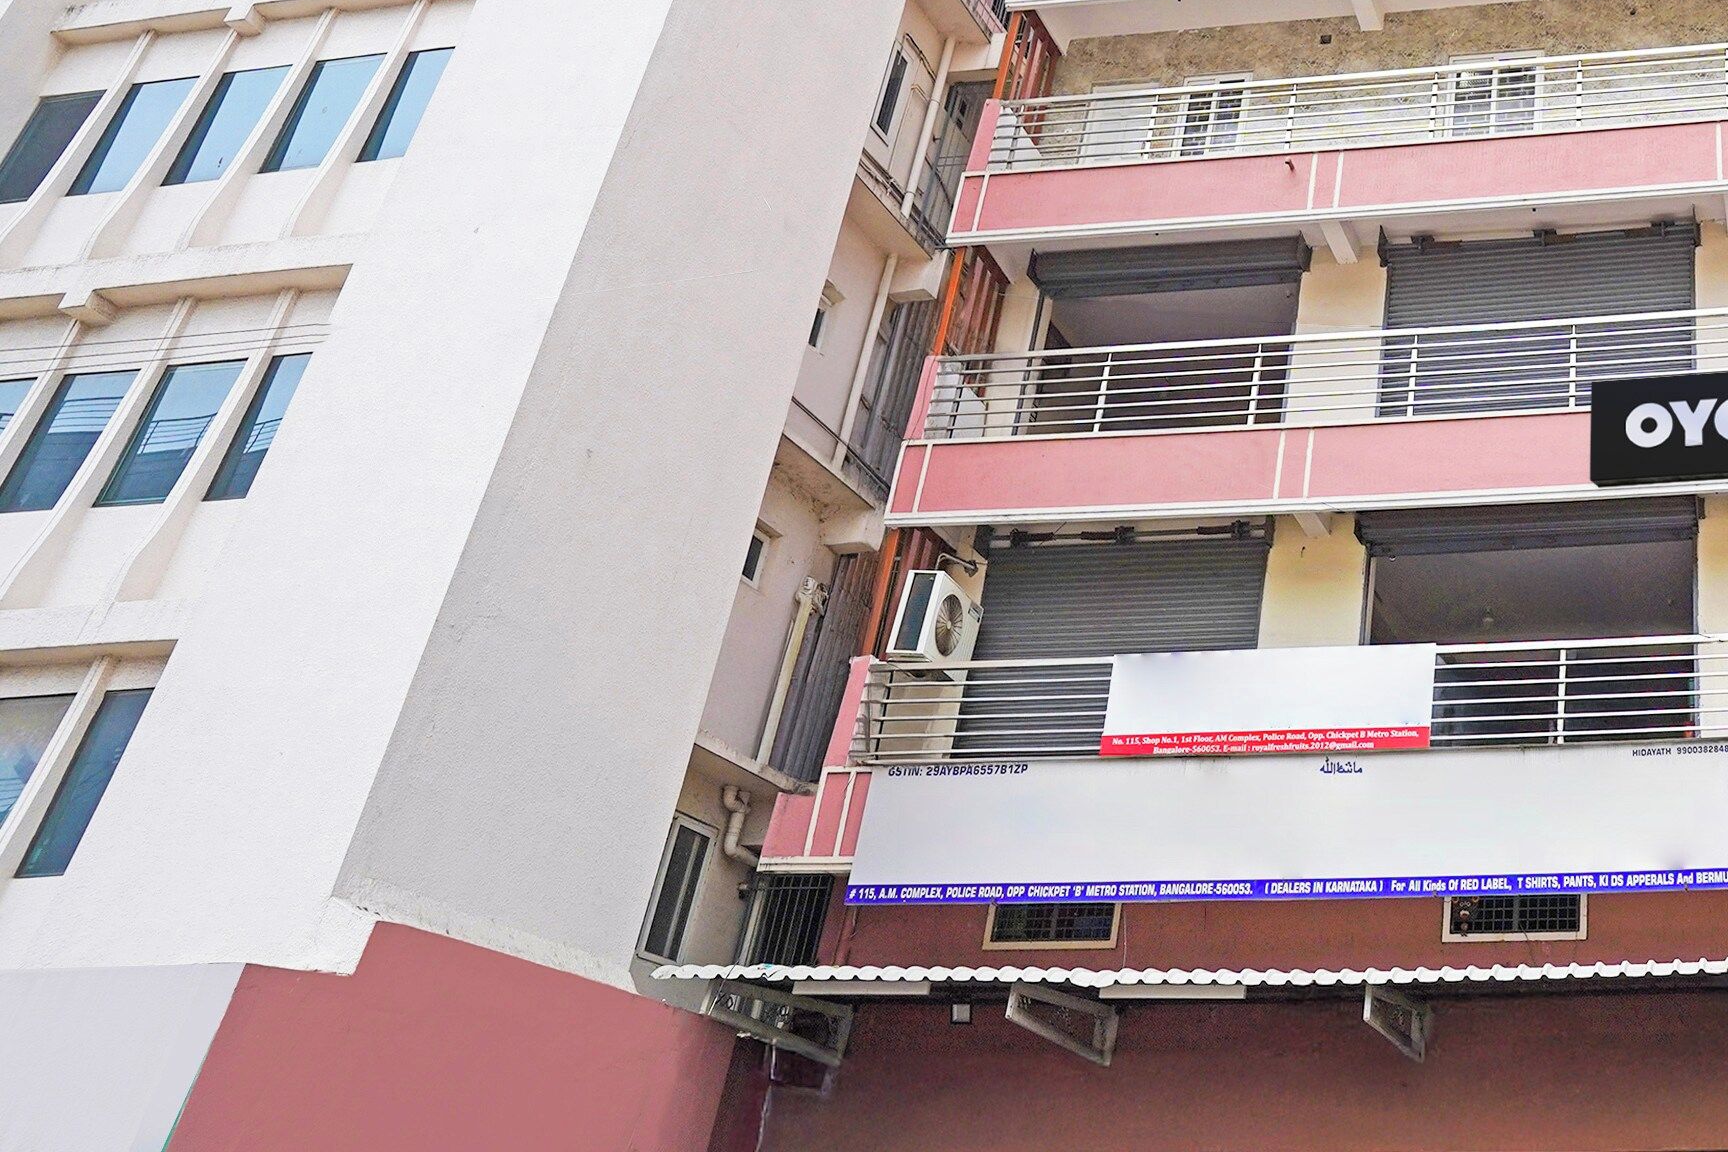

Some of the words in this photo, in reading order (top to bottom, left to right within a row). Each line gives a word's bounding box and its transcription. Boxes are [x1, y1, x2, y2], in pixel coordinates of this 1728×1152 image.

[1112, 737, 1125, 745] No.
[1125, 736, 1141, 745] 115,
[1142, 735, 1160, 746] Shop
[1161, 734, 1180, 744] No.1,
[1181, 734, 1193, 743] 1st
[1215, 733, 1227, 742] AM
[1228, 732, 1261, 743] Complex,
[1263, 732, 1285, 740] Police
[1286, 731, 1307, 741] Road,
[1308, 731, 1325, 741] Opp.
[1326, 729, 1359, 740] Chickpet
[1360, 729, 1366, 738] B
[1367, 729, 1389, 738] Metro
[1390, 728, 1419, 738] Station,
[1223, 743, 1246, 752] E-mail
[1632, 748, 1672, 757] HIDAYATH
[858, 888, 876, 899] 115,
[878, 888, 898, 899] A.M.
[900, 887, 944, 899] COMPLEX,
[945, 887, 977, 898] POLICE
[977, 886, 1004, 898] ROAD,
[1006, 886, 1025, 897] OPP
[1027, 886, 1071, 897] CHICKPET
[1085, 885, 1117, 896] METRO
[1118, 884, 1158, 897] STATION,
[1159, 882, 1254, 895] BANGALORE-560053.
[1270, 882, 1312, 894] DEALERS
[1312, 882, 1324, 893] IN
[1325, 881, 1378, 892] KARNATAKA
[1390, 880, 1406, 892] For
[1408, 880, 1421, 891] All
[1423, 879, 1447, 891] Kinds
[1448, 879, 1460, 890] Of
[1460, 879, 1480, 890] RED
[1481, 878, 1511, 891] LABEL,
[1518, 878, 1526, 888] T
[1525, 876, 1561, 889] SHIRTS,
[1563, 875, 1597, 888] PANTS,
[1611, 875, 1624, 886] DS
[1626, 873, 1675, 885] APPERALS
[1676, 872, 1694, 884] And
